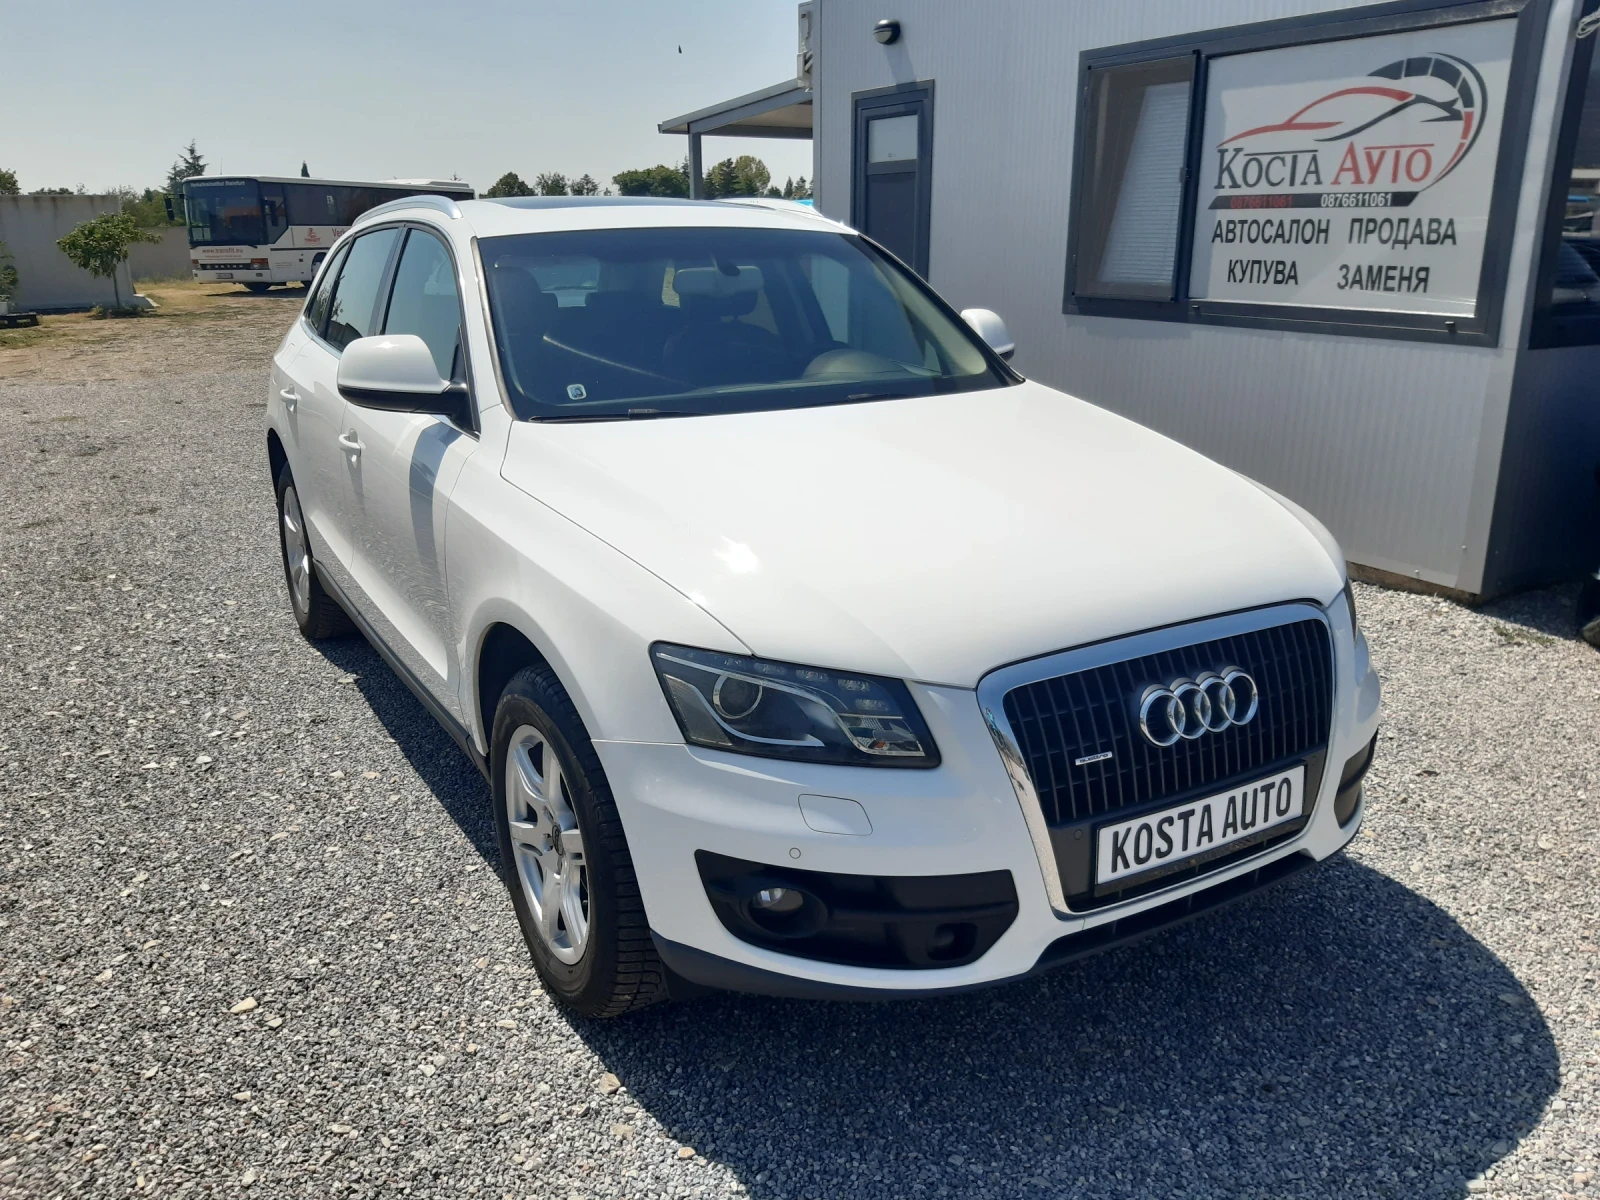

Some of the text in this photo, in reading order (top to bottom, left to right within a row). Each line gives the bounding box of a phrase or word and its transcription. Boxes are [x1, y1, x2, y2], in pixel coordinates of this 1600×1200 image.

[1320, 192, 1392, 208] 0876611061
[1211, 217, 1457, 250] АВТОСАЛОН ПРОДАВА
[1227, 259, 1430, 293] КУПУВА ЗАМЕНЯ
[1110, 777, 1292, 874] KOSTA AUTO
